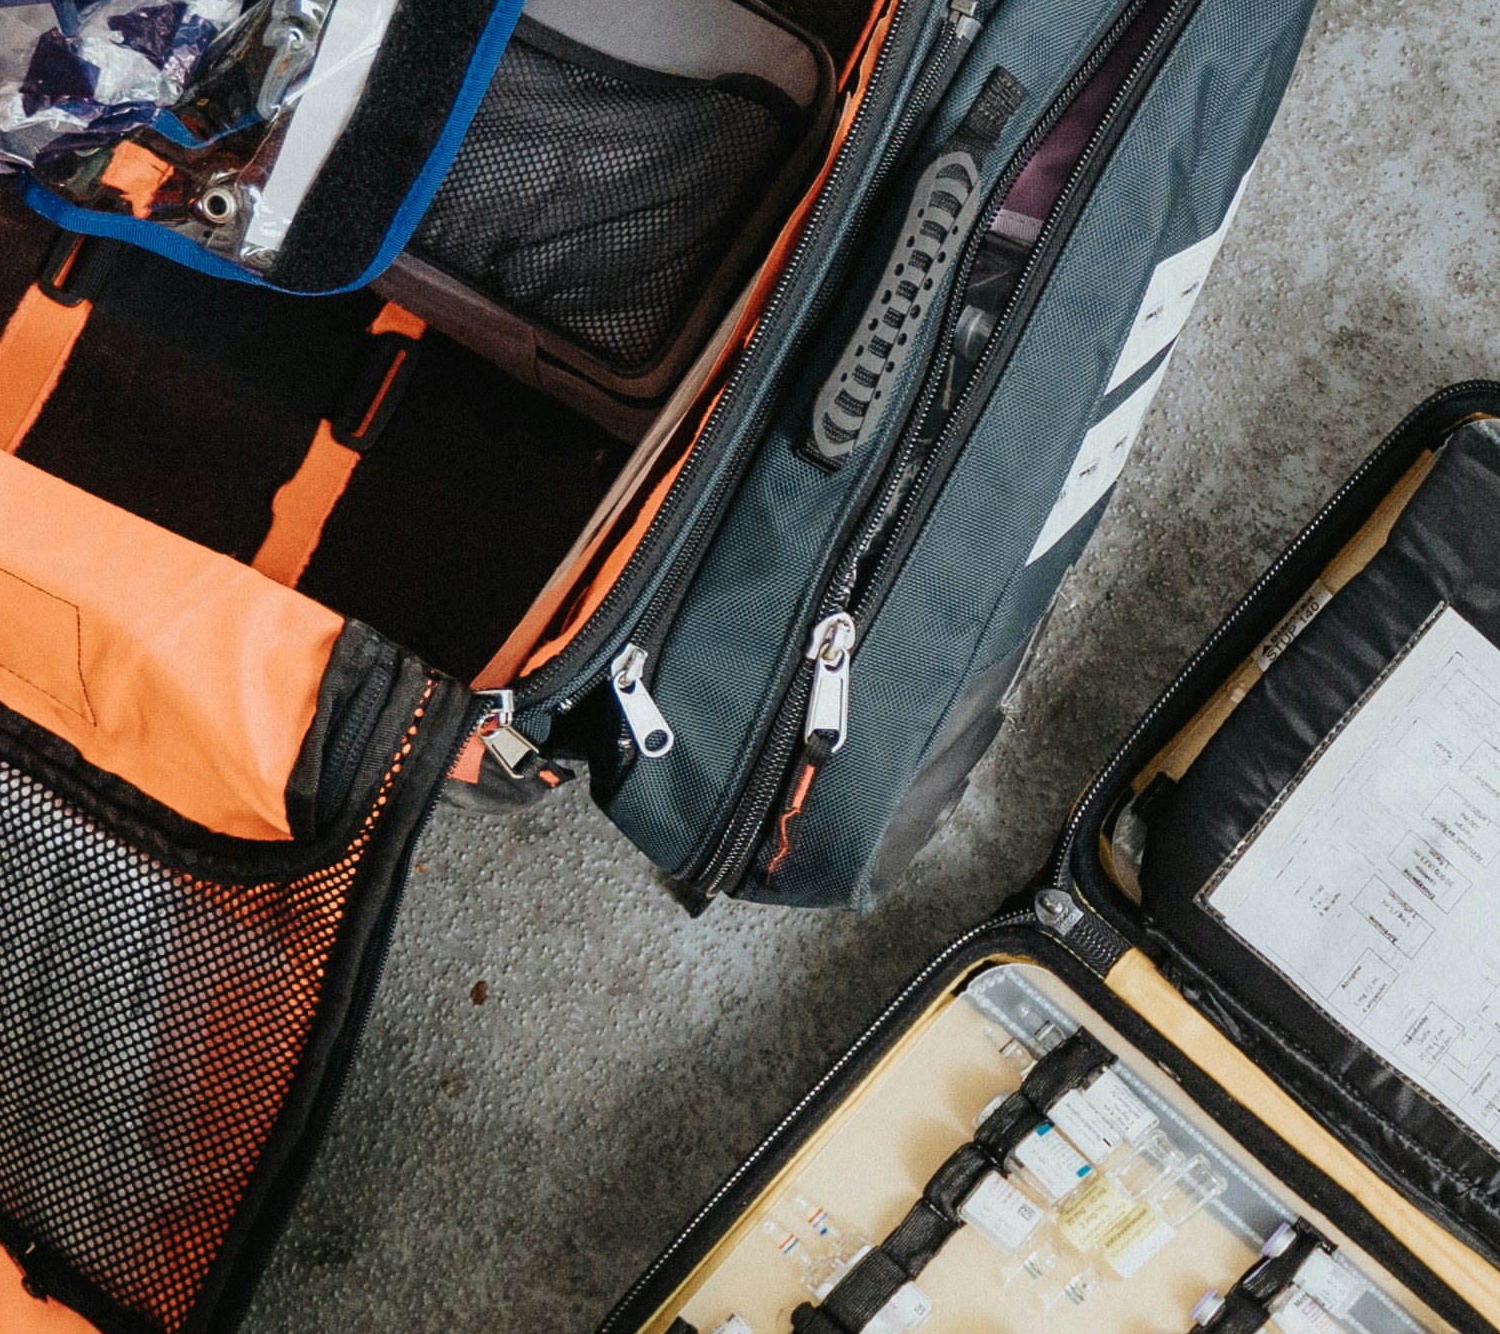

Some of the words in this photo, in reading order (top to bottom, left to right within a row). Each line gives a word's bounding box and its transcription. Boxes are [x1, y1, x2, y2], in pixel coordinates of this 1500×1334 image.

[1264, 623, 1301, 662] STUP
[1298, 600, 1321, 624] 140
[1339, 963, 1363, 990] Atropine
